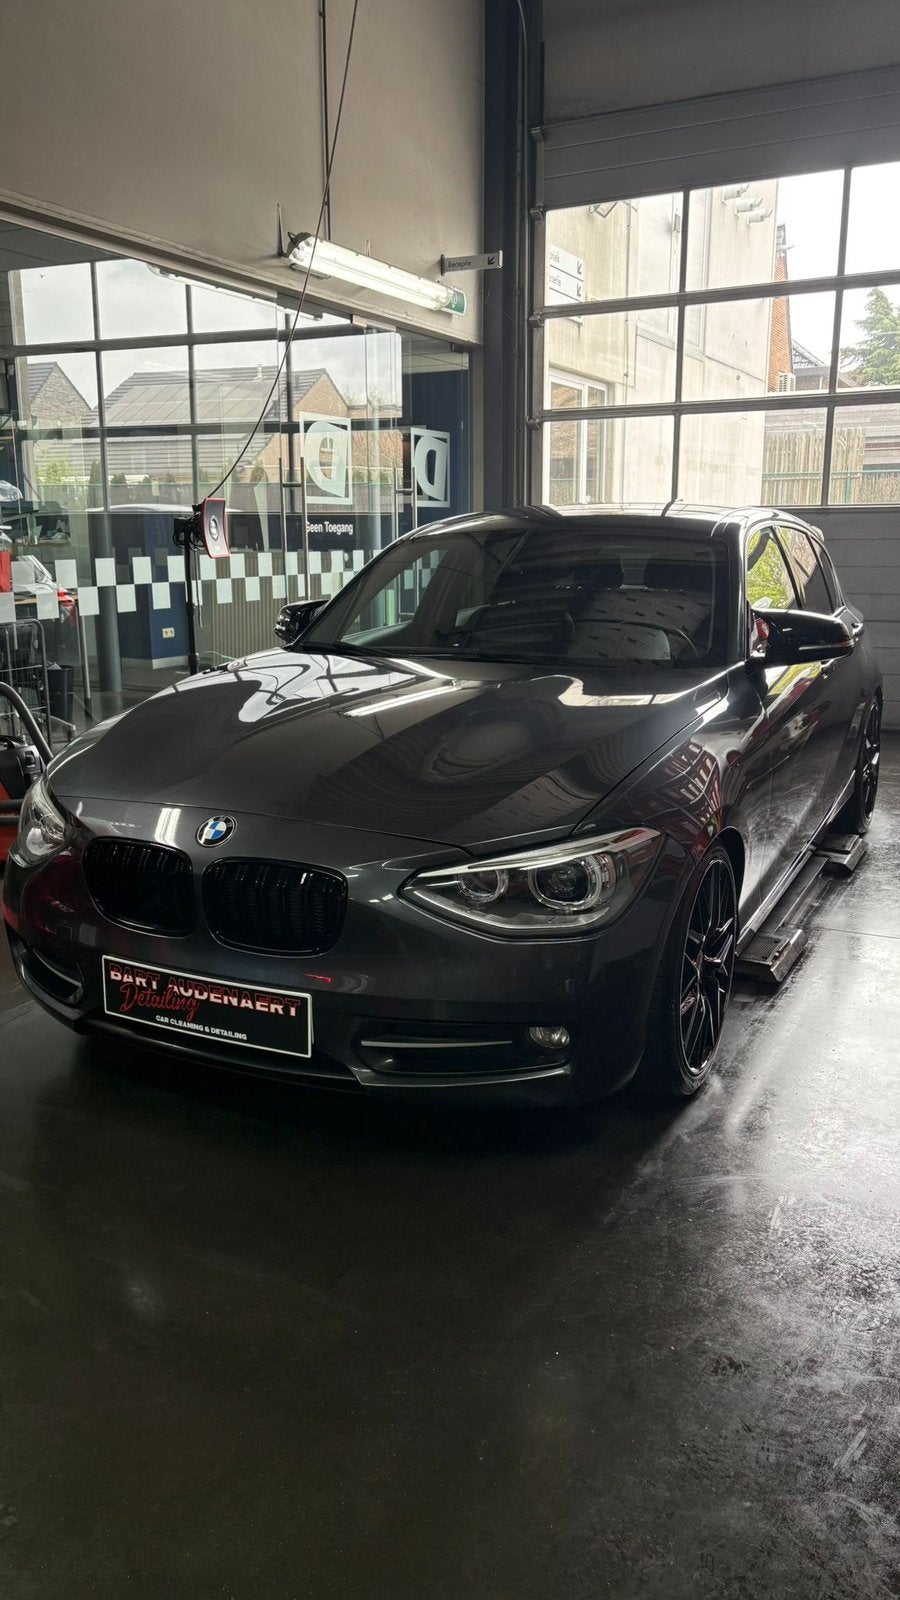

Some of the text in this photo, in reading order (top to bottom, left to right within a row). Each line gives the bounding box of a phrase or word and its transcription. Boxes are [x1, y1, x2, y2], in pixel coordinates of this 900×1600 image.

[448, 260, 471, 269] Receptie
[324, 521, 353, 535] Toegang
[109, 962, 299, 1017] BART AUDENAERT
[120, 984, 199, 1021] Detailing
[155, 1014, 247, 1040] CAR CLEANING & DETAILING
